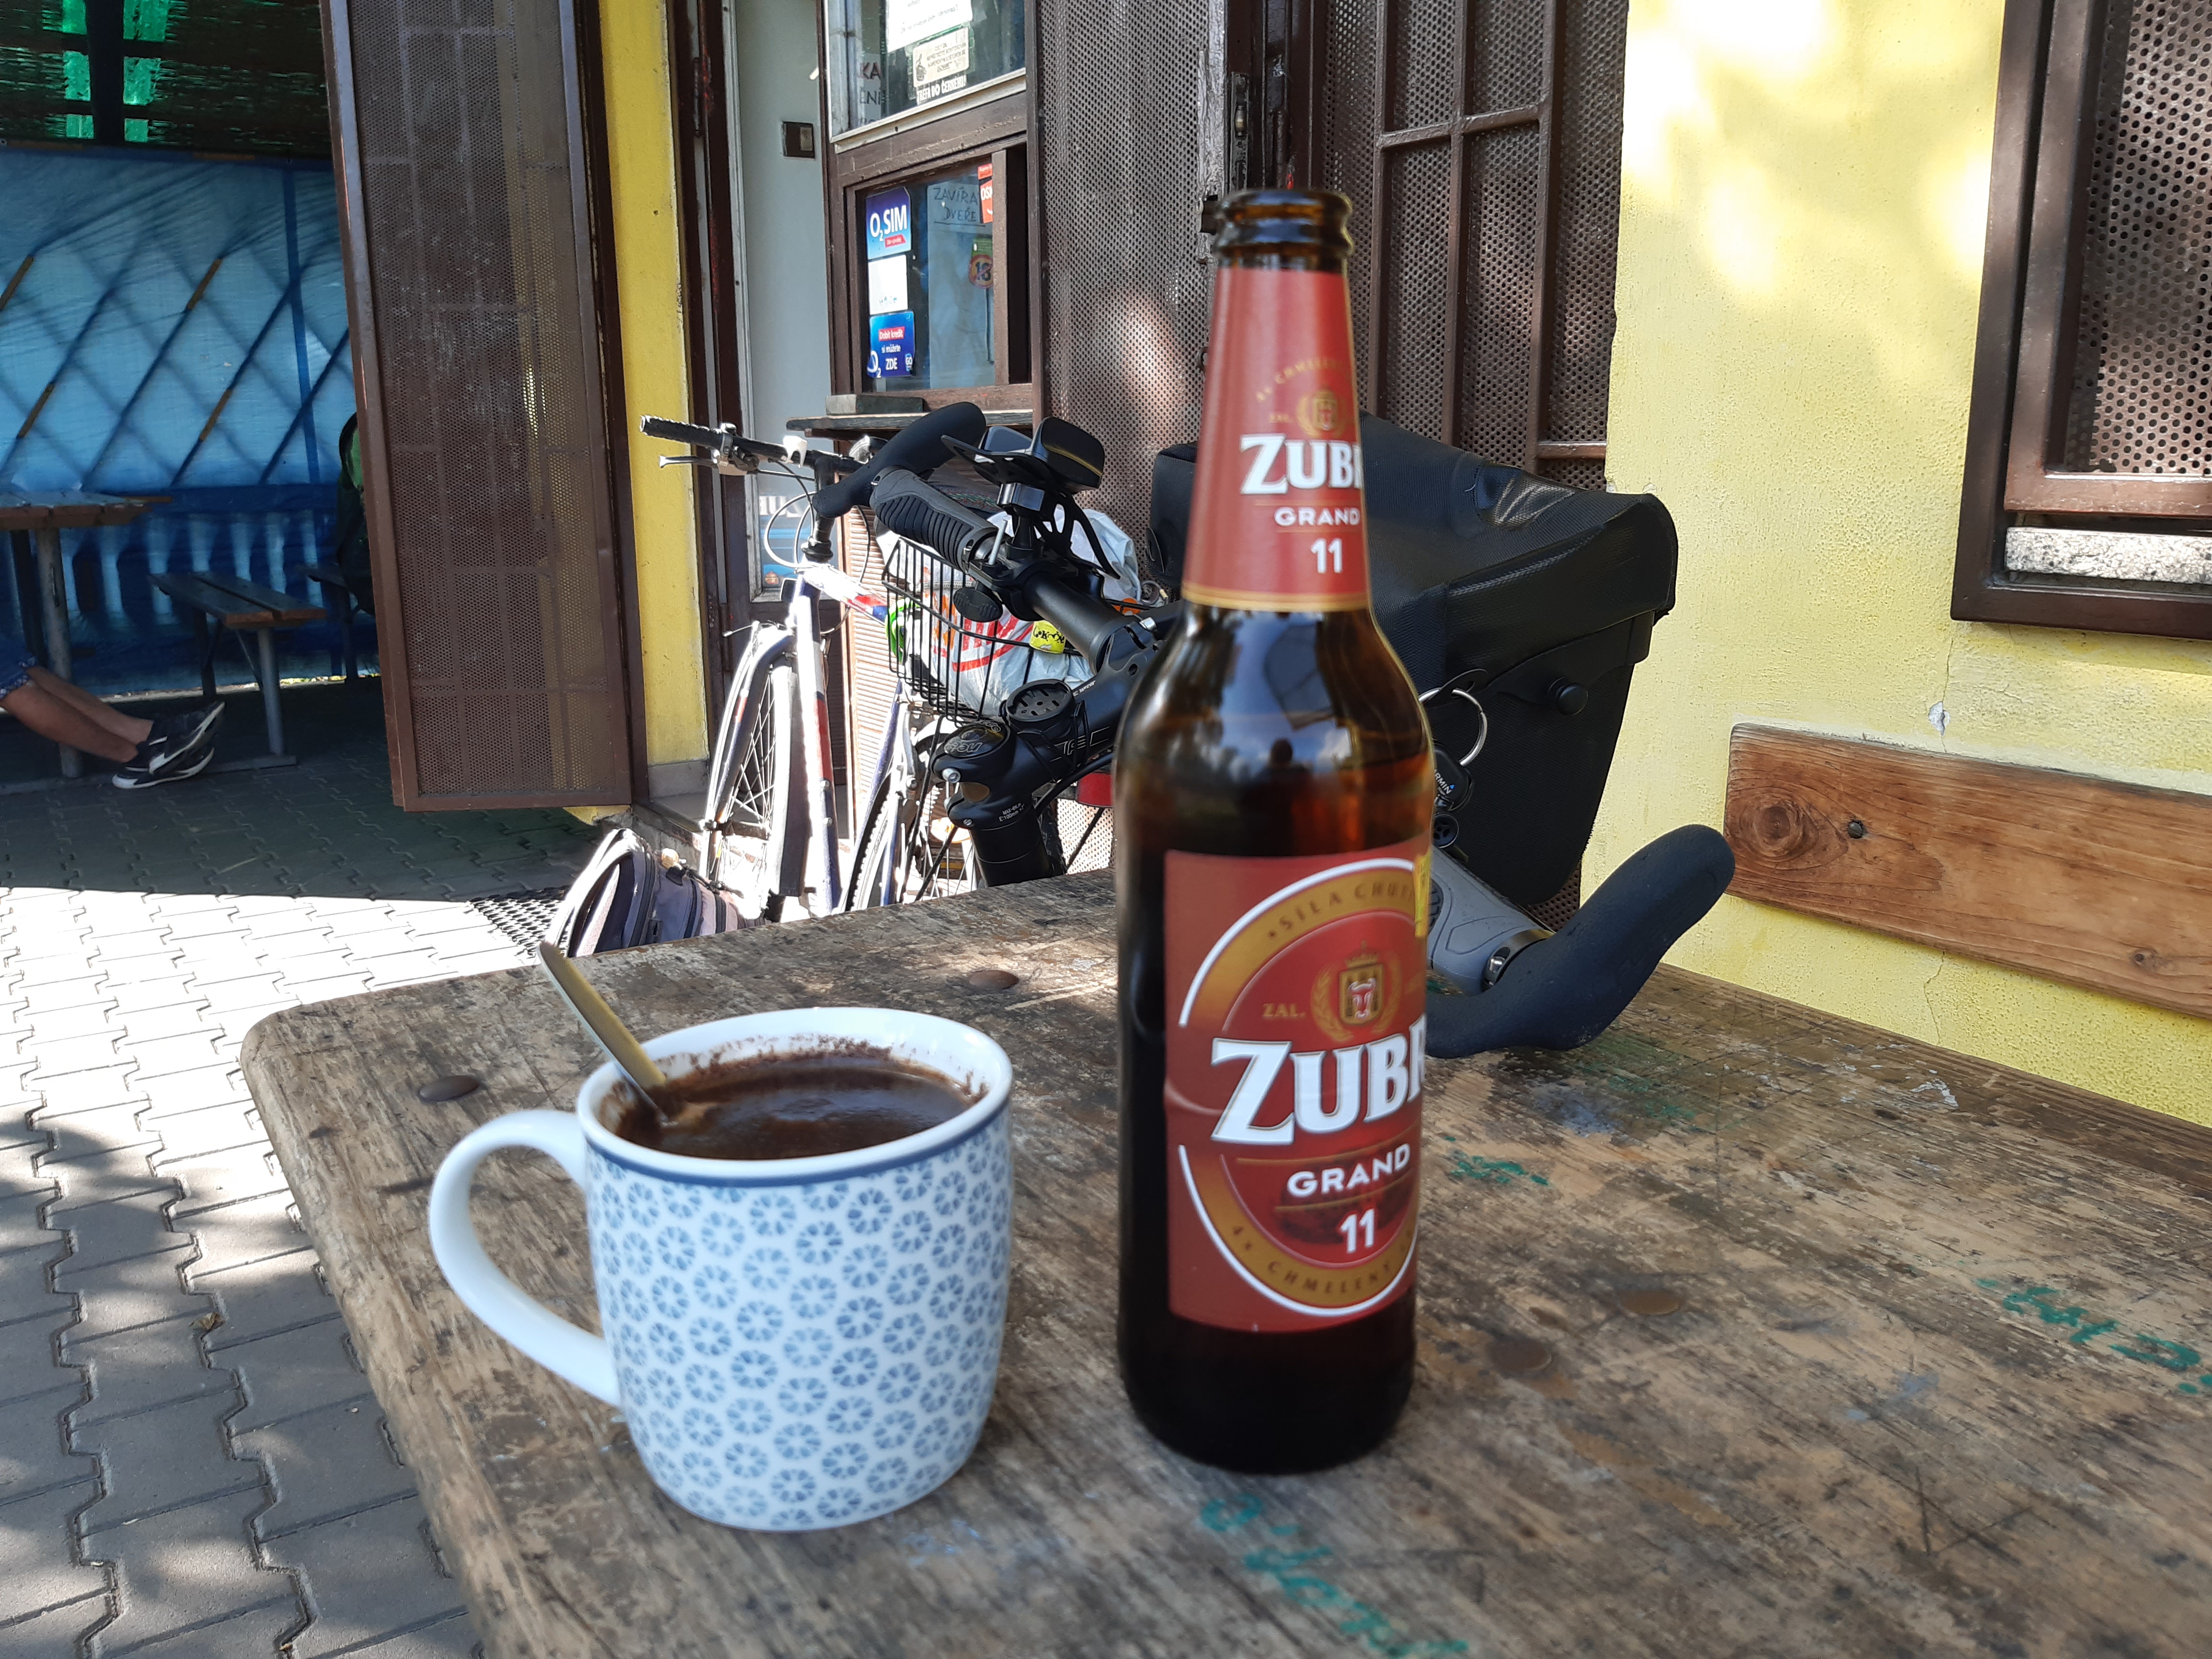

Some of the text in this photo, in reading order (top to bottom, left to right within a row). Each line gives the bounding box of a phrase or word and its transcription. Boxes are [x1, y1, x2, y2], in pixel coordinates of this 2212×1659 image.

[931, 84, 940, 97] DO
[884, 204, 907, 234] SIM
[885, 358, 898, 371] ZDE
[1274, 507, 1360, 526] GRAND
[1310, 538, 1343, 574] 11
[1434, 769, 1452, 794] RMIN
[1286, 1142, 1411, 1198] GRAND
[1339, 1208, 1377, 1253] 11
